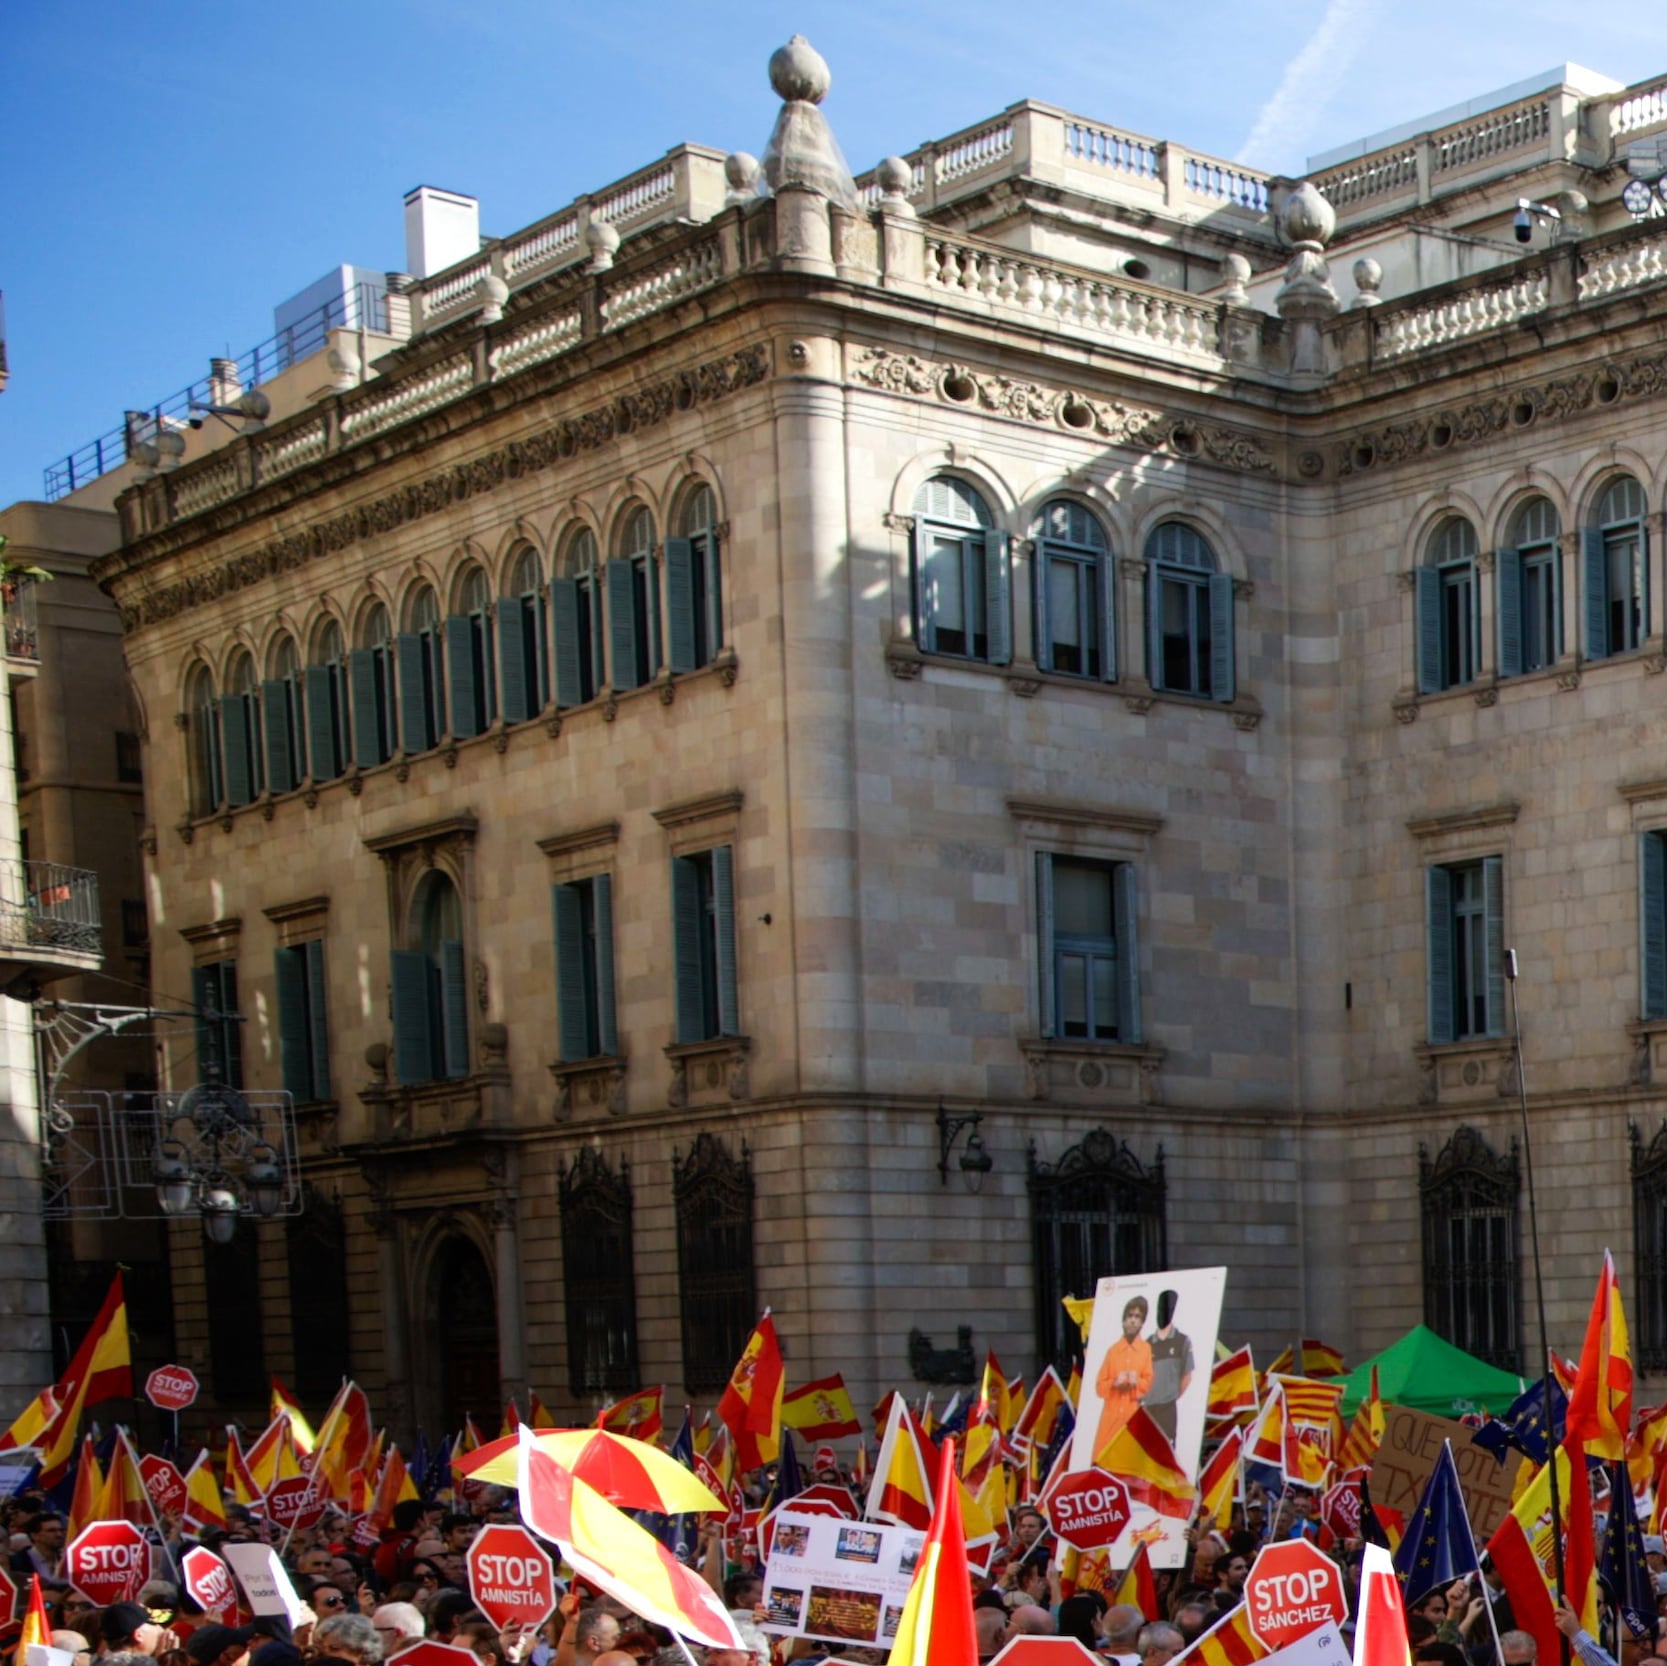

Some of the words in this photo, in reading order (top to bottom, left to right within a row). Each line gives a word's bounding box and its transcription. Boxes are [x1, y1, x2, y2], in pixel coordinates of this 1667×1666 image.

[154, 1373, 194, 1393] STOP
[1452, 1400, 1476, 1411] VOX
[1391, 1412, 1447, 1461] QUE
[1455, 1446, 1503, 1488] OTE
[1054, 1479, 1119, 1520] STOP
[1340, 1489, 1361, 1520] STO
[1060, 1508, 1124, 1534] AMNISTÍA
[196, 1565, 228, 1602] STOP
[478, 1553, 543, 1588] STOP
[480, 1587, 545, 1607] AMNISTÍA
[1254, 1568, 1330, 1612] STOP
[1259, 1603, 1333, 1632] SÁNCHEZ
[1627, 1611, 1645, 1632] ppe
